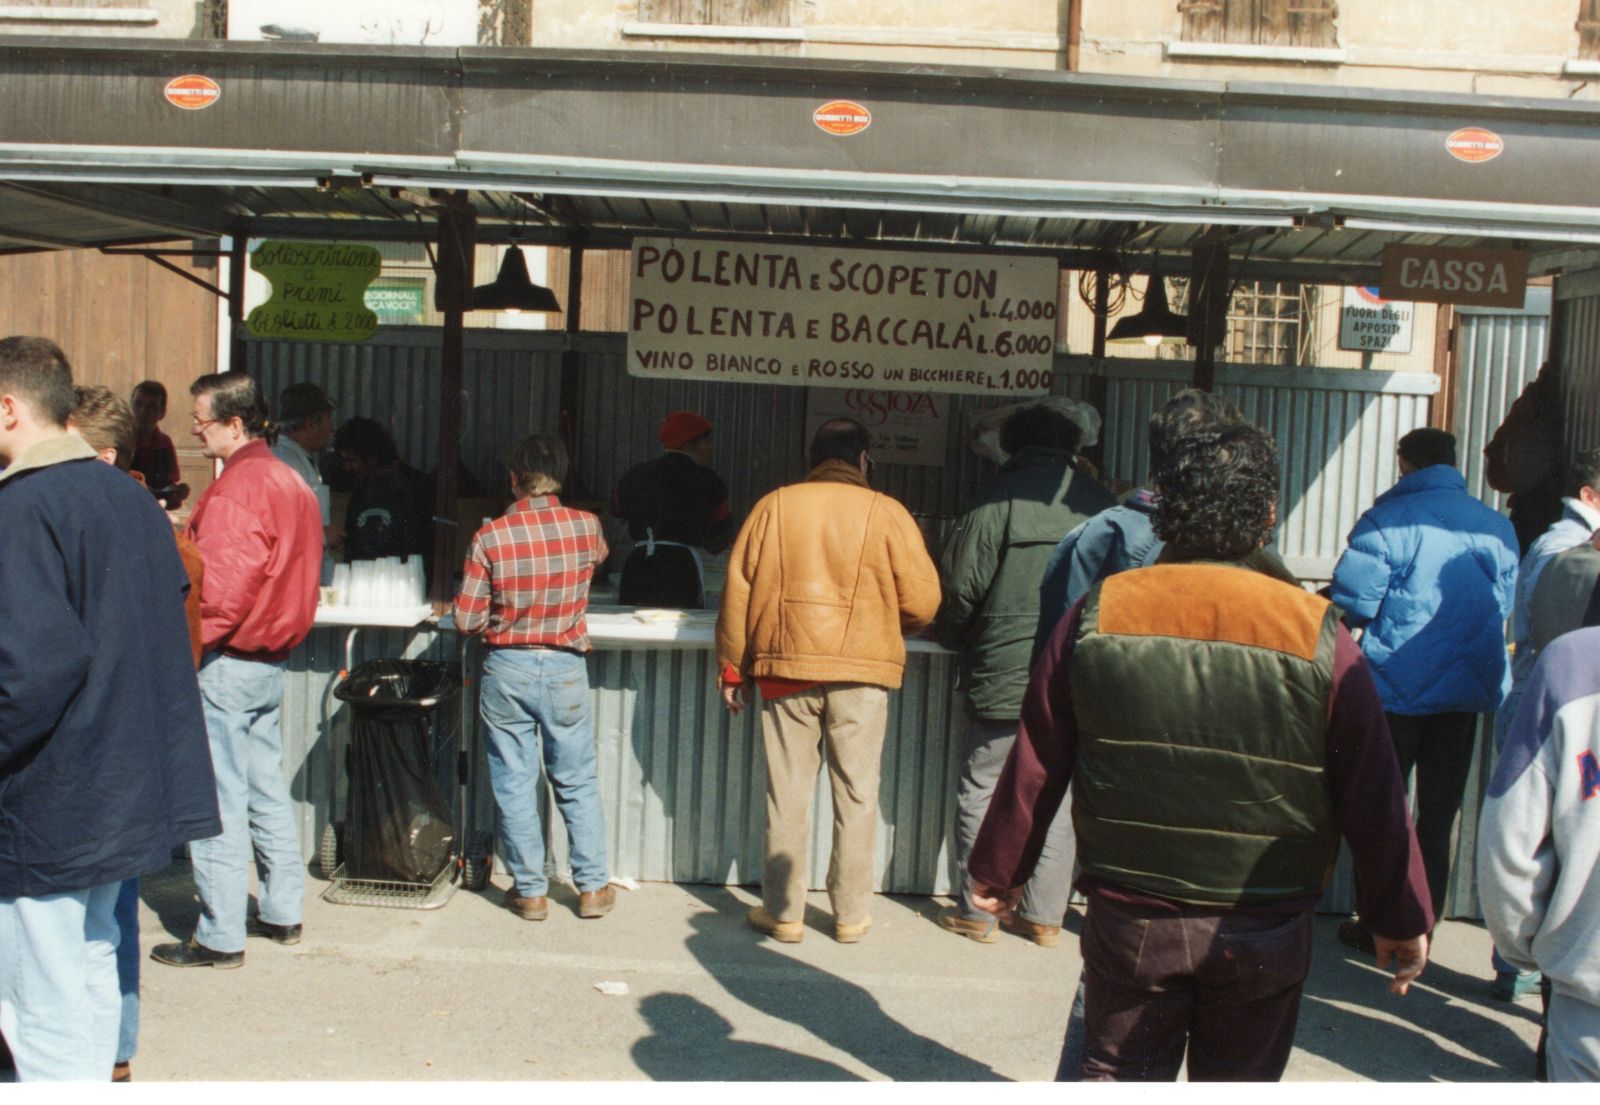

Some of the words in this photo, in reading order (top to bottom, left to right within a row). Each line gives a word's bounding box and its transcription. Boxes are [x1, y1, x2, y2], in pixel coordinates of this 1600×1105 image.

[636, 246, 802, 290] POLENTA
[810, 274, 821, 290] E
[828, 259, 997, 299] SCOPETON
[1401, 257, 1509, 294] CASSA
[283, 283, 345, 303] Premi
[633, 298, 796, 339] POLENTA
[806, 319, 820, 339] E
[830, 312, 975, 350] BACCALÀ
[1345, 307, 1377, 319] FUORI
[1382, 308, 1410, 321] DEGLI
[1353, 321, 1401, 335] APPOSITI
[635, 350, 694, 370] VINO
[706, 353, 782, 375] BIANCO
[791, 364, 799, 376] E
[808, 358, 874, 379] ROSSO
[883, 368, 904, 381] UN
[909, 368, 985, 385] BICCHIERE
